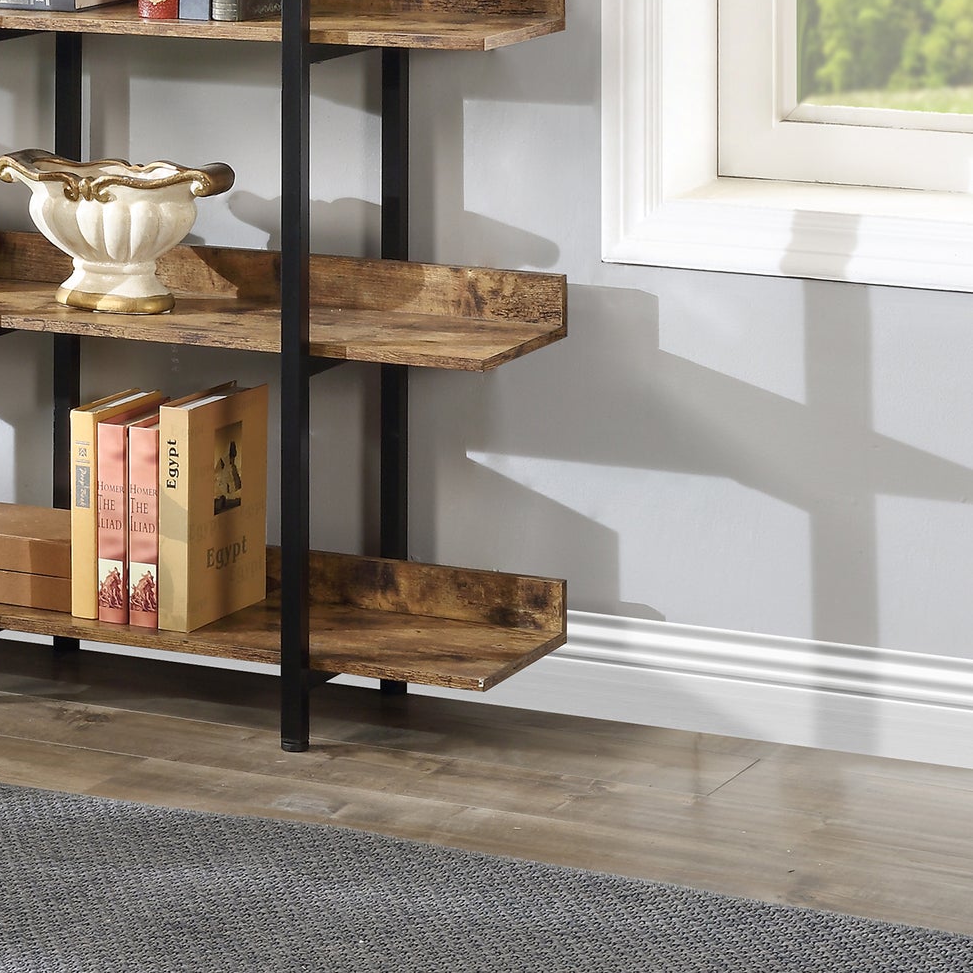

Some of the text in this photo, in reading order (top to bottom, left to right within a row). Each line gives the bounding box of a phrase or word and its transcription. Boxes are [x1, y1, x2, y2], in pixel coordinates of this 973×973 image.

[165, 439, 179, 489] Egypt
[98, 481, 125, 493] HOMER
[130, 483, 158, 497] HOMER
[98, 494, 116, 511] THE
[130, 497, 149, 514] THE
[131, 515, 155, 533] ILIAD
[206, 534, 248, 570] Egypt
